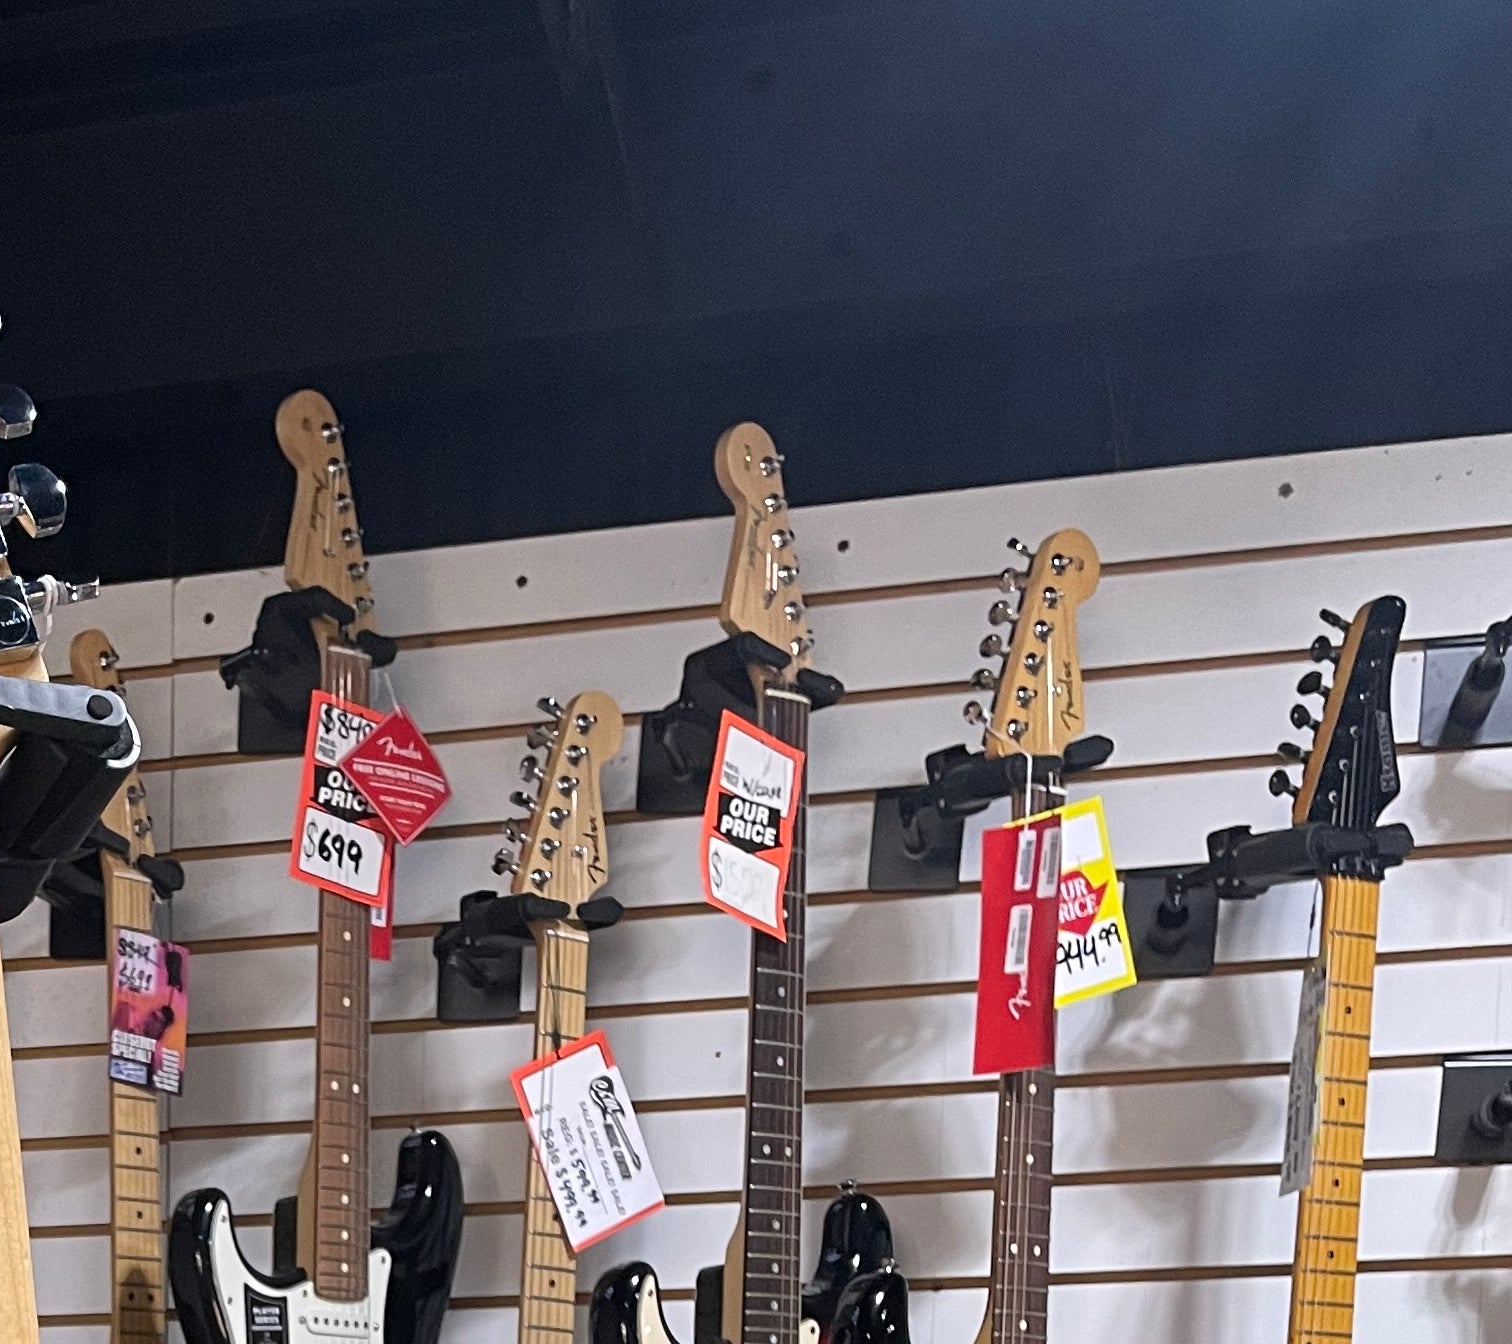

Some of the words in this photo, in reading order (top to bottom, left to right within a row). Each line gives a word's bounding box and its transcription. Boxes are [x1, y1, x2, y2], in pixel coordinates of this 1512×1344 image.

[1057, 660, 1081, 731] Fender
[318, 786, 367, 813] PRIC
[729, 798, 770, 826] OUR
[719, 815, 777, 847] PRICE
[303, 818, 364, 877] $699
[581, 816, 606, 884] Fender
[1060, 877, 1088, 902] UR
[1058, 893, 1099, 924] RICE
[540, 1127, 561, 1166] Sale
